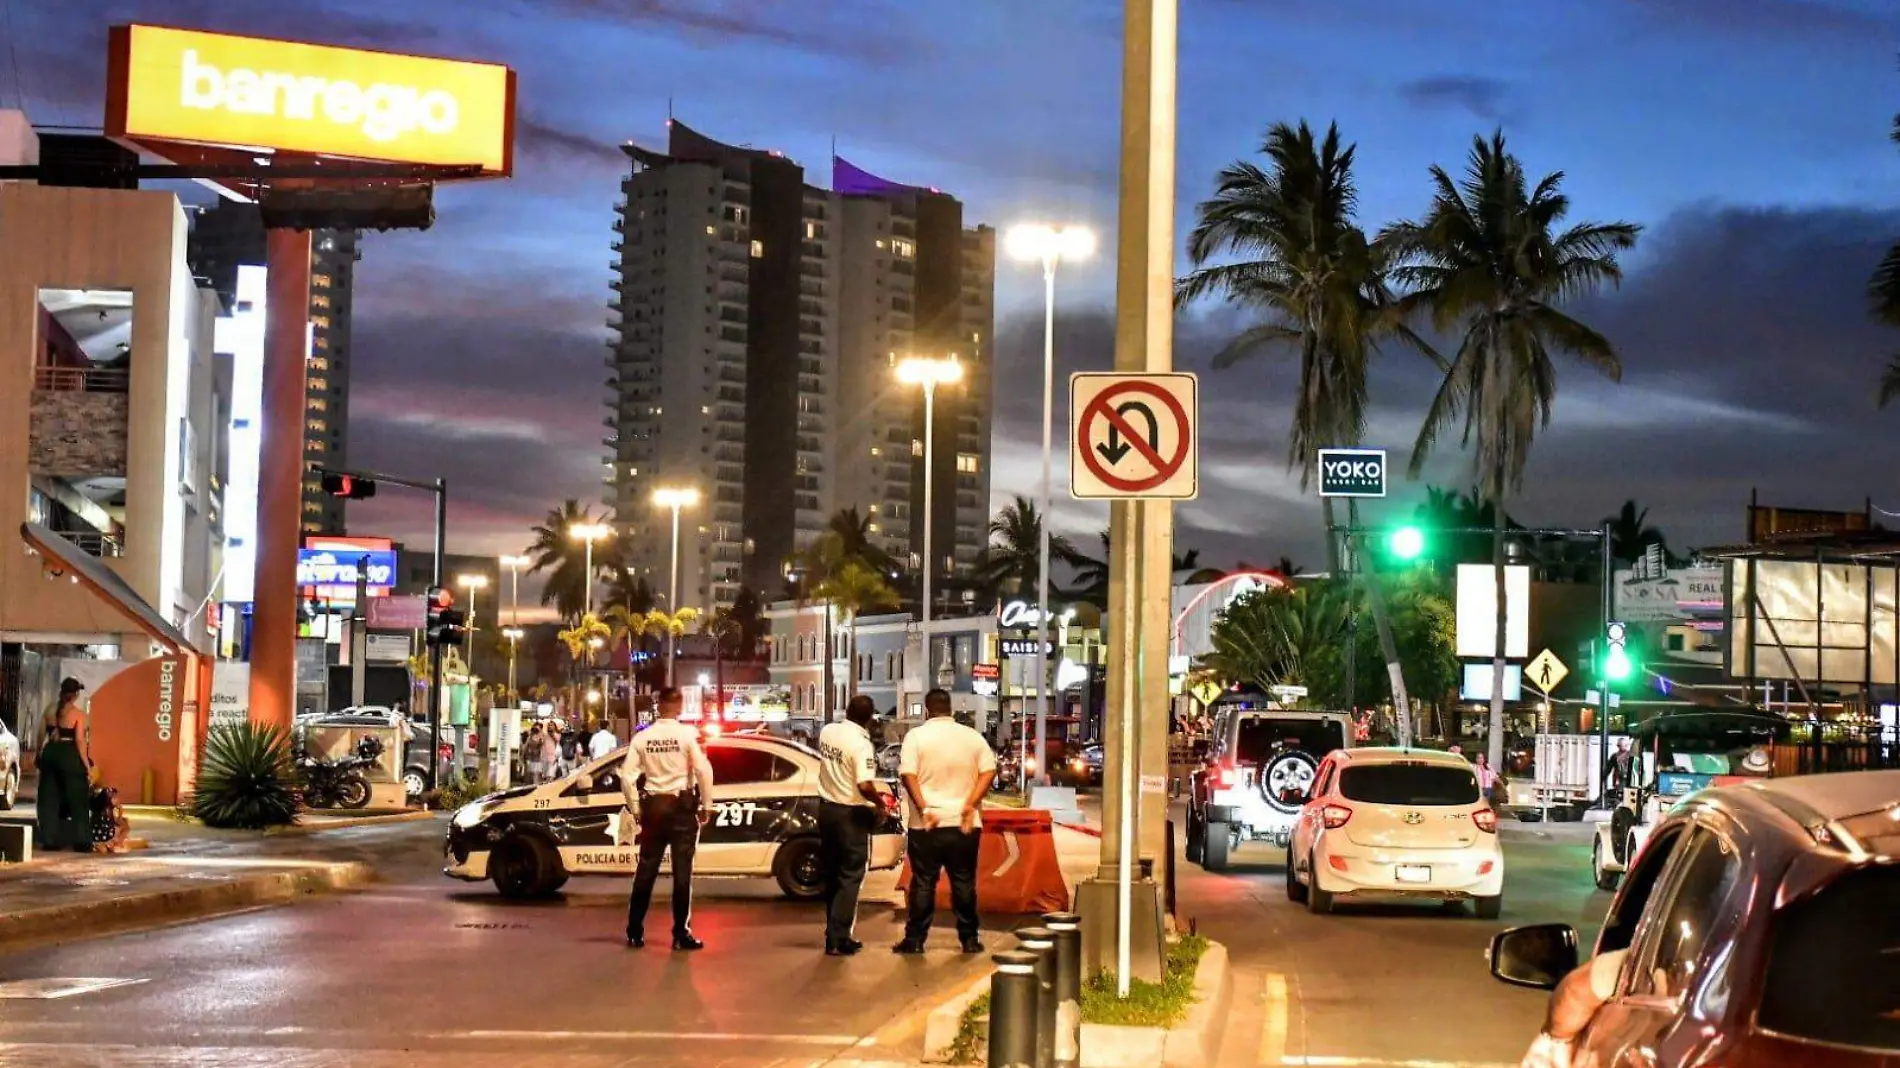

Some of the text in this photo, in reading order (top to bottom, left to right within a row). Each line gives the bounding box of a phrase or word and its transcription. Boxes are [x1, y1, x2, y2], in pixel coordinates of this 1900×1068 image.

[180, 49, 460, 141] banregio
[1324, 460, 1380, 478] YOKO
[1689, 583, 1716, 593] REAL
[155, 660, 177, 741] banregio
[210, 693, 237, 703] ditos
[534, 799, 550, 808] 297
[716, 803, 756, 827] 297
[576, 853, 615, 864] POLICIA
[618, 853, 631, 863] DE
